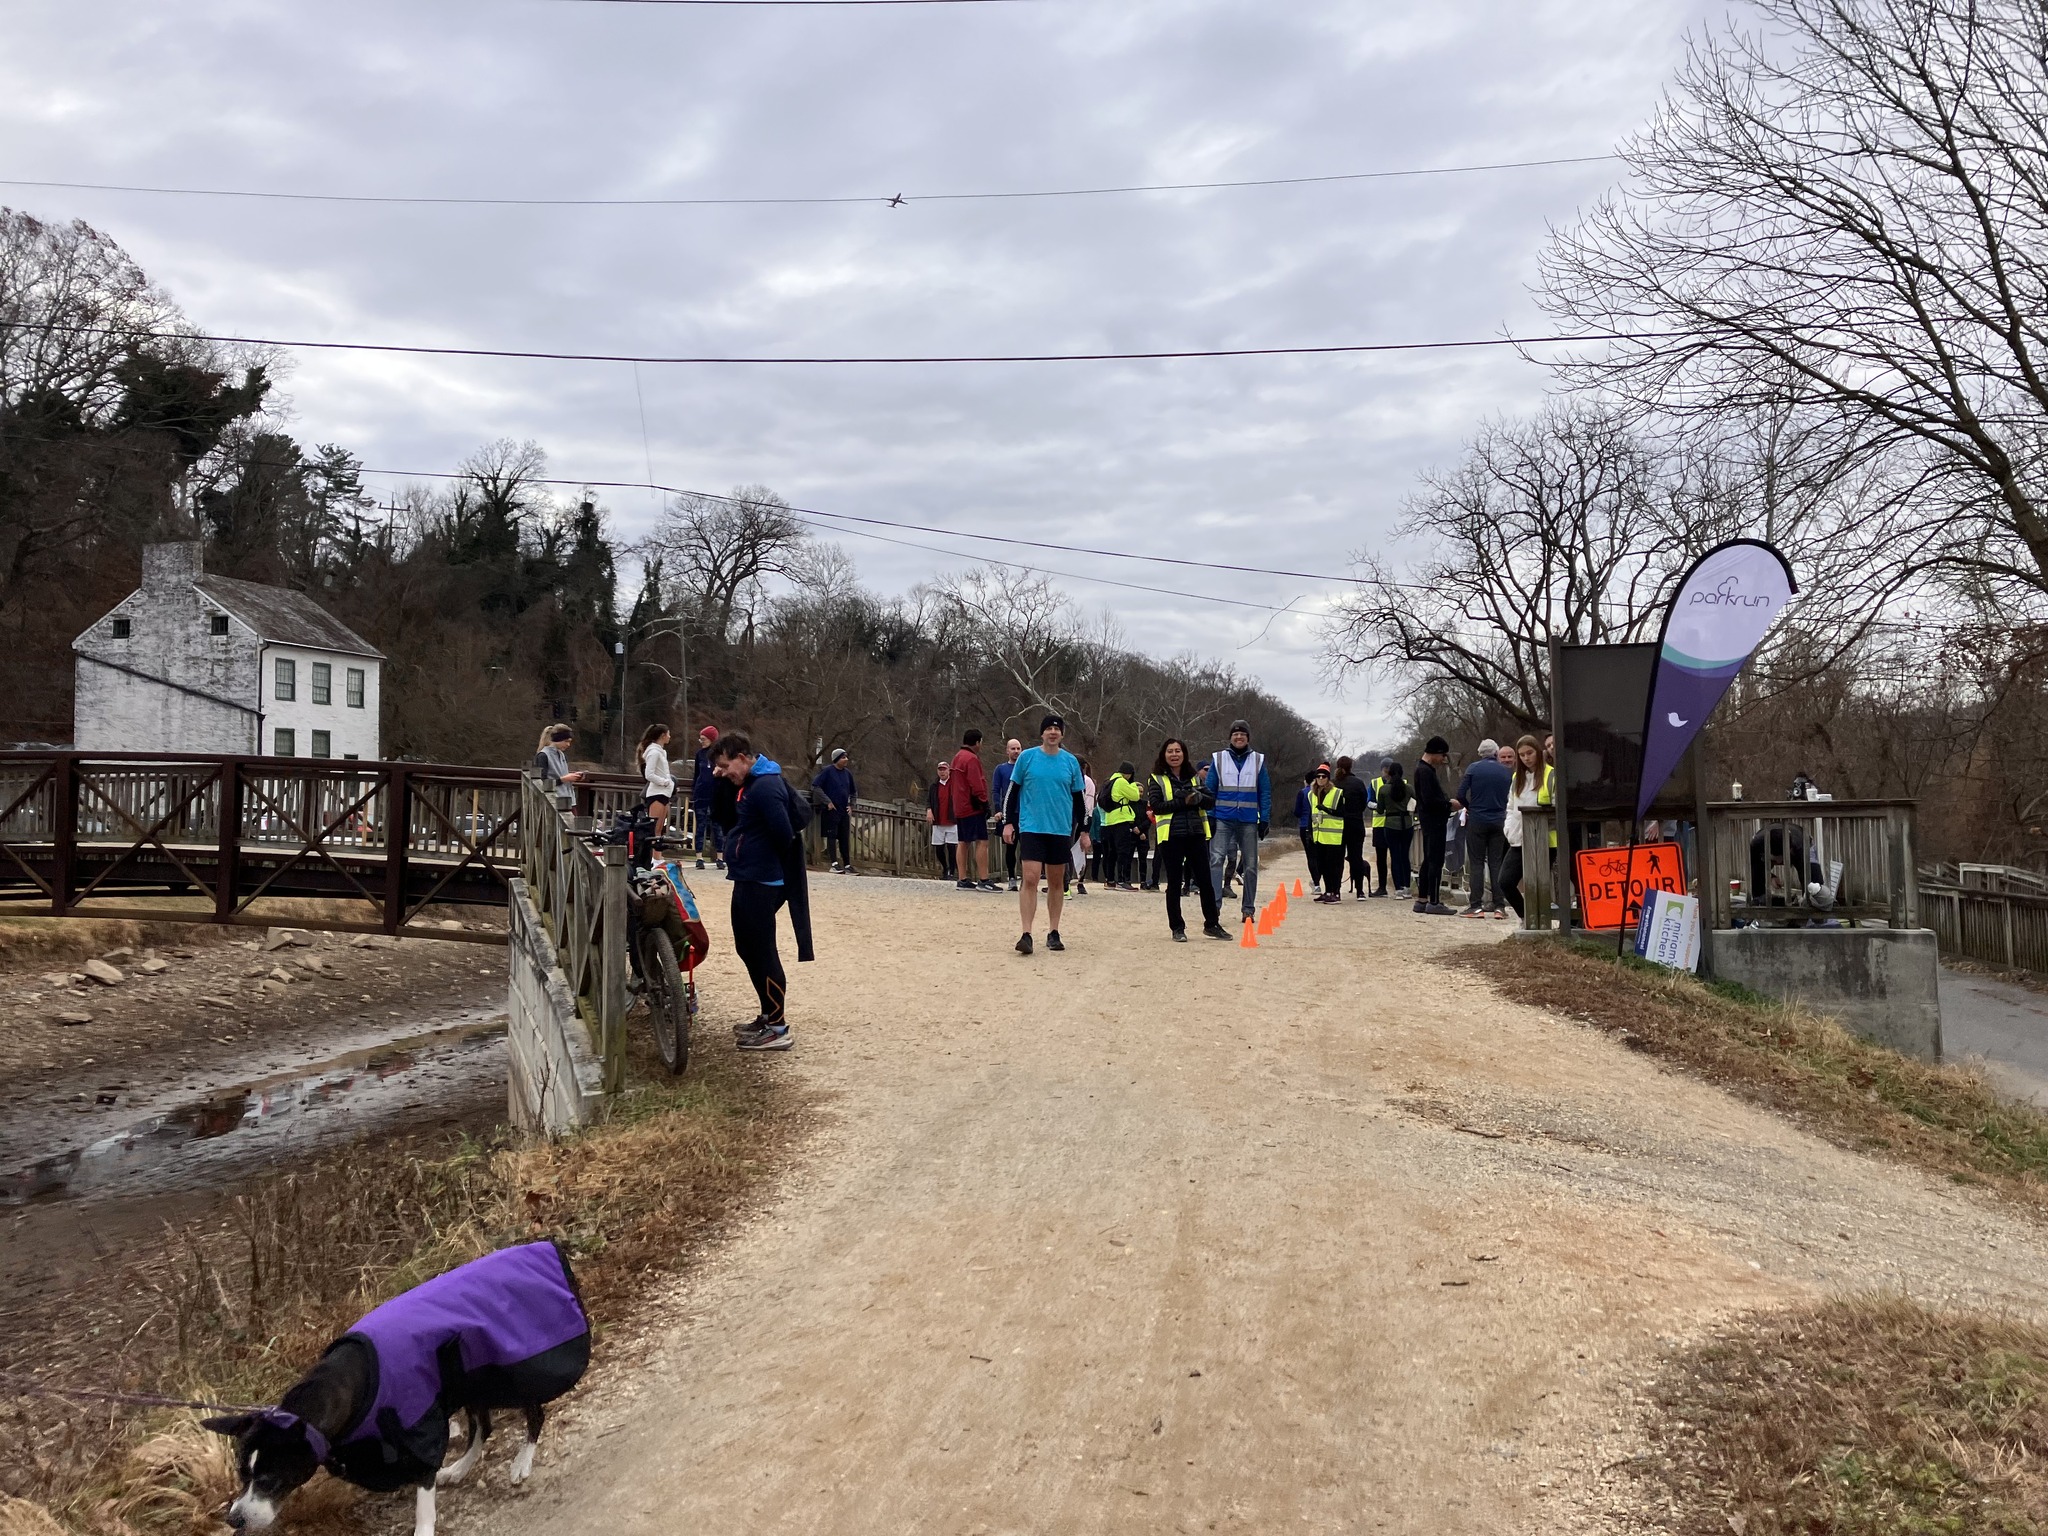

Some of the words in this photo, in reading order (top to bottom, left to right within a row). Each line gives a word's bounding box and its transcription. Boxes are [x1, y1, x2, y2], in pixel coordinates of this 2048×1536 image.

[1689, 576, 1769, 607] parkrun
[1589, 877, 1676, 901] DETOUR
[1658, 917, 1675, 957] kitchen
[1667, 921, 1683, 967] miriam's
